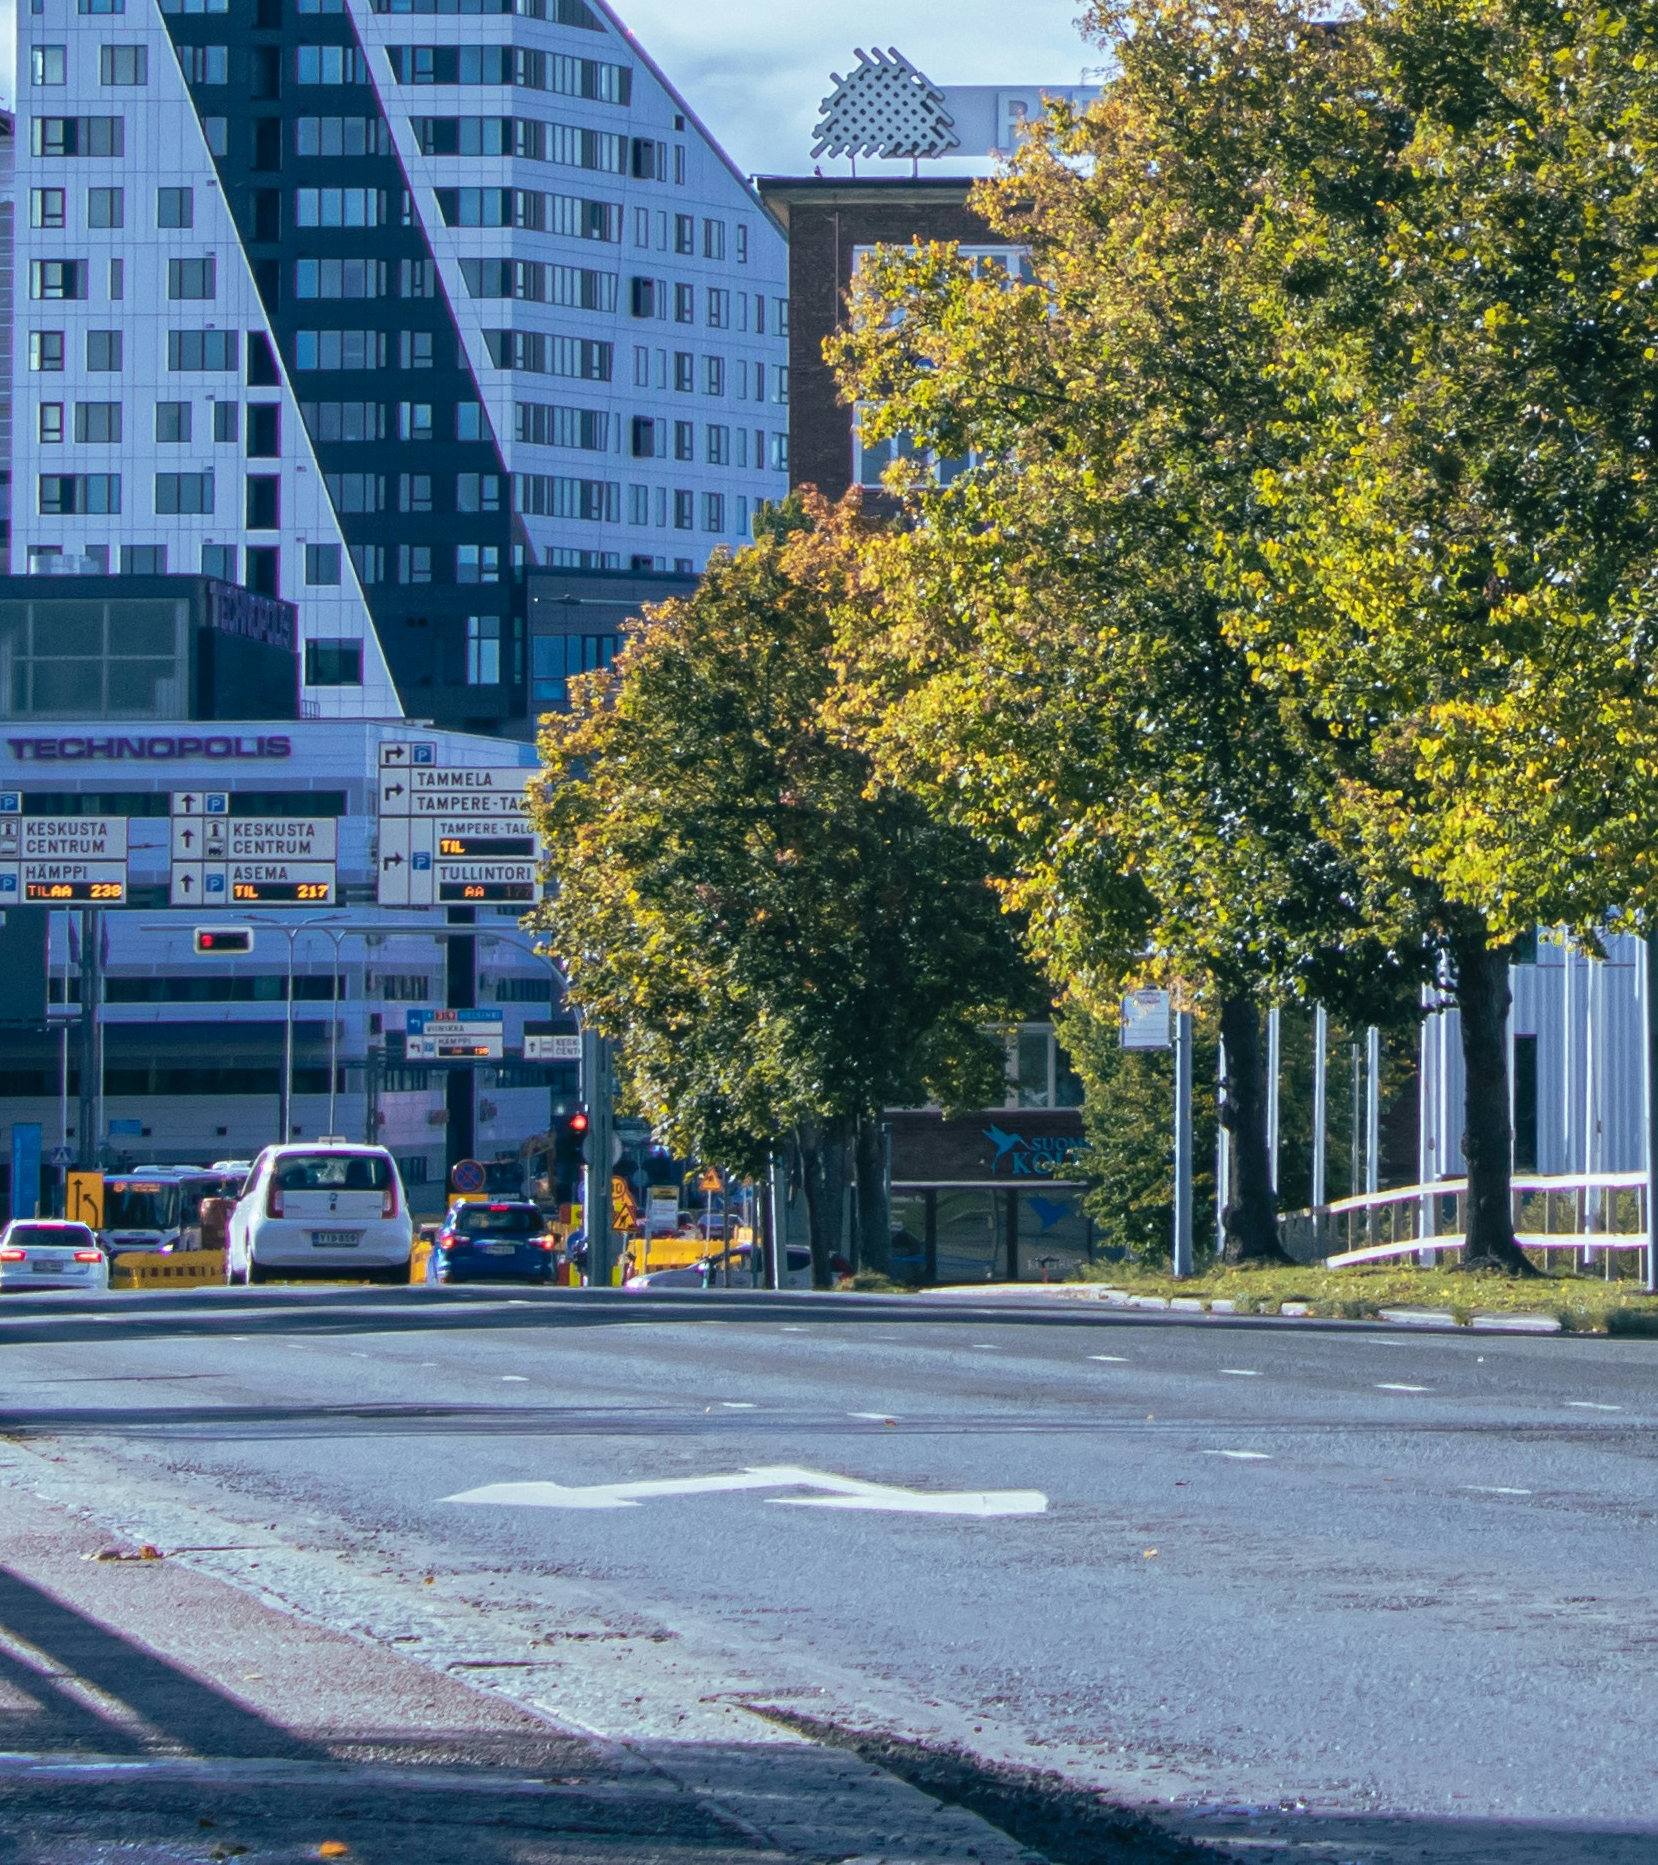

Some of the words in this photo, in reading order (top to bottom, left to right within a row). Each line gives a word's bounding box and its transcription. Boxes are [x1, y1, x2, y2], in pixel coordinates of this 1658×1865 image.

[7, 736, 292, 760] TECHNOPOLIS
[417, 772, 493, 786] TAMMELA
[417, 796, 530, 811] TAMPERE-TA
[26, 822, 108, 837] KESKUSTA
[233, 823, 315, 838] KESKUSTA
[26, 838, 105, 854] CENTRUM
[233, 840, 312, 855] CENTRUM
[441, 840, 465, 853] TIL
[25, 864, 88, 880] HÄMPPI
[233, 866, 289, 881] ASEMA
[440, 866, 531, 881] TULLINTORI
[27, 885, 73, 897] TILAA
[90, 885, 122, 897] 238
[233, 885, 259, 898] TIL
[297, 885, 328, 898] 217
[556, 1038, 579, 1046] KESK
